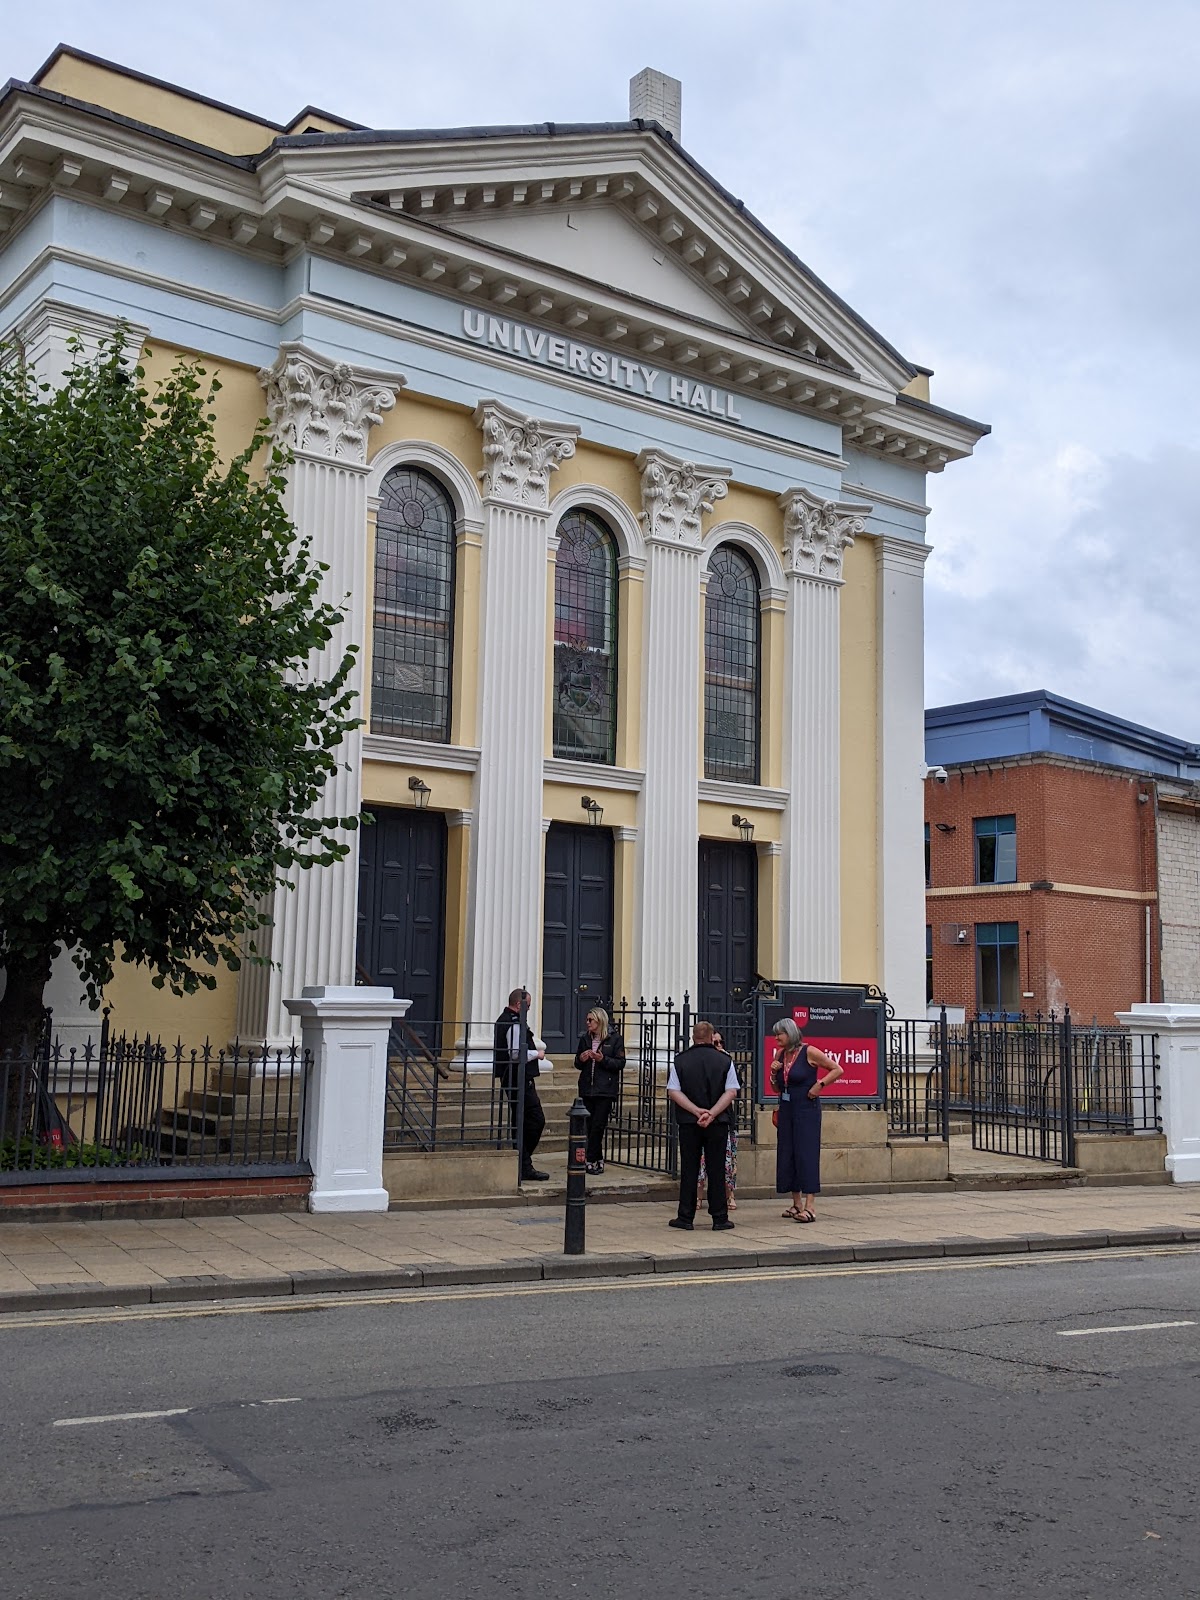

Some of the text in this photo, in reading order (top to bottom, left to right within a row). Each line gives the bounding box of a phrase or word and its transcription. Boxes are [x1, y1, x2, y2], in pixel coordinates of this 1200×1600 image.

[463, 309, 742, 421] UNIVERSITY HALL
[845, 1049, 869, 1064] Hall
